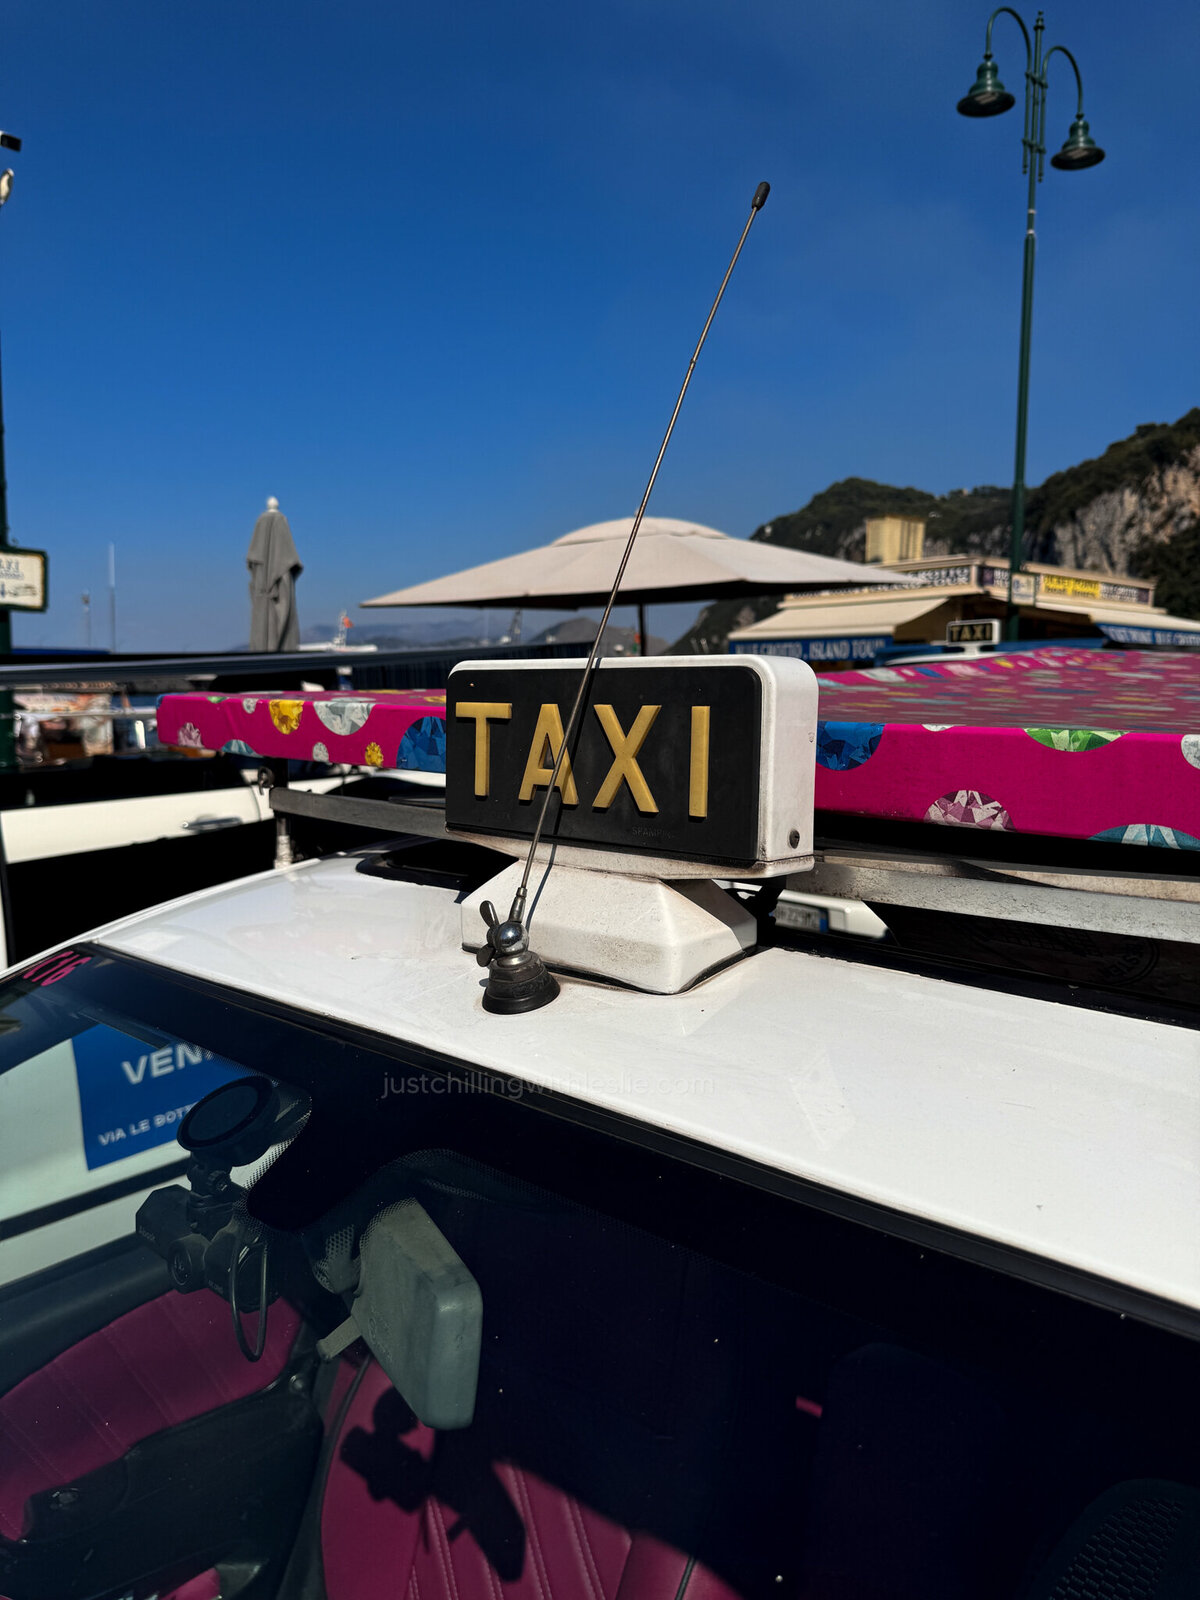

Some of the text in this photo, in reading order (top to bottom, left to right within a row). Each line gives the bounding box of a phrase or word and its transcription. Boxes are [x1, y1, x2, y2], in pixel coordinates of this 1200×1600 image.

[951, 624, 991, 642] TAXI
[455, 702, 711, 819] TAXI
[98, 1127, 126, 1147] VIA
[129, 1118, 151, 1136] LE
